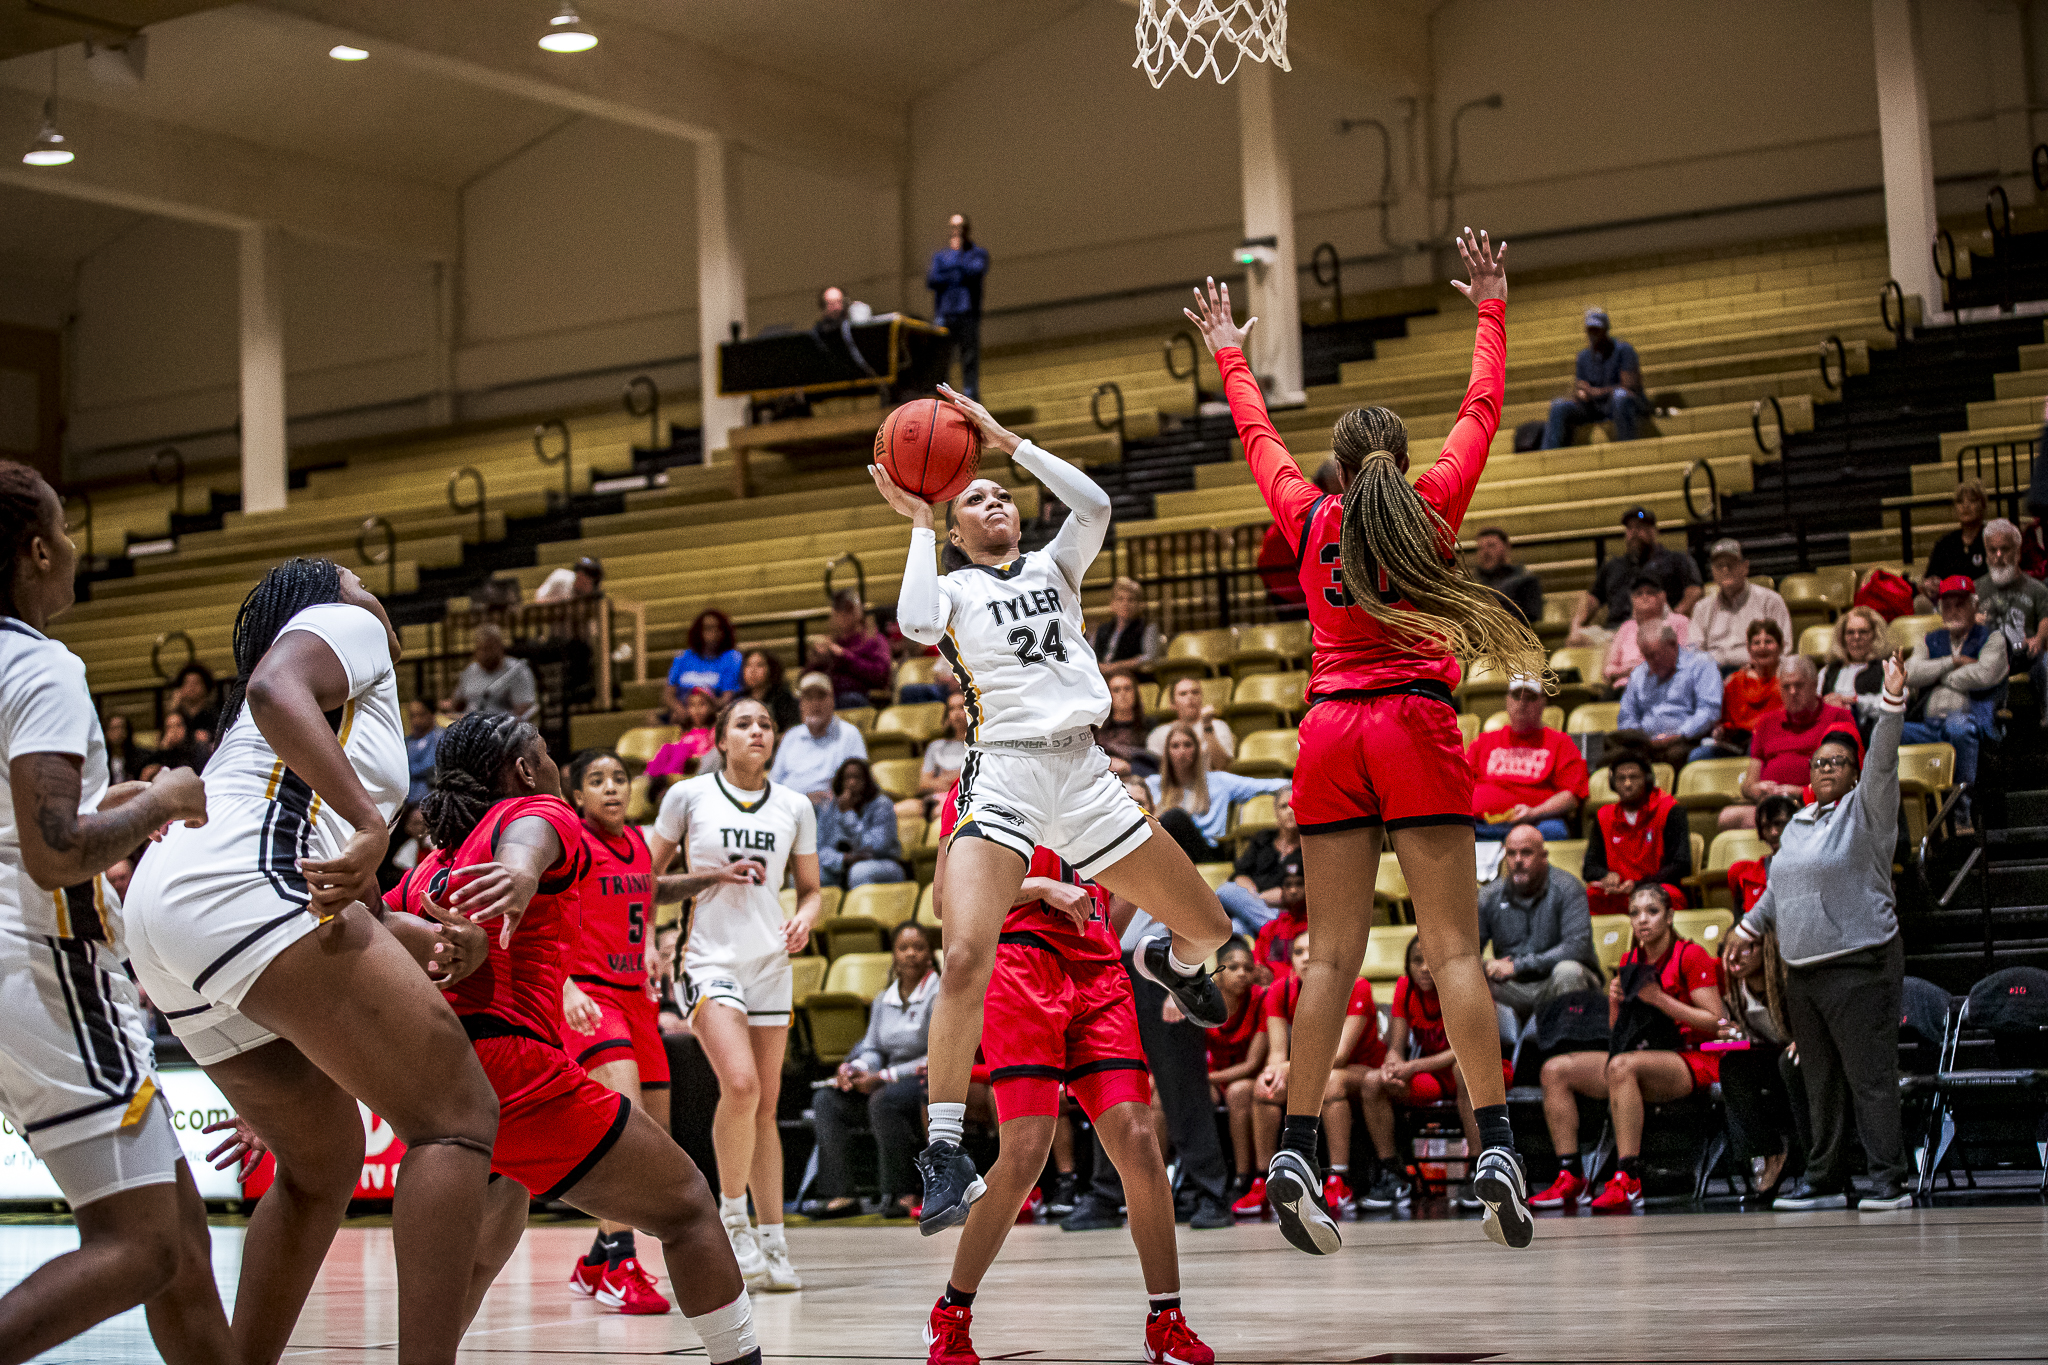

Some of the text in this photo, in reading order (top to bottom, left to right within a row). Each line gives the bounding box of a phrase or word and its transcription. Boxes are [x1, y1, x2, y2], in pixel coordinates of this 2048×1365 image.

[987, 586, 1063, 628] TYLER
[1007, 618, 1069, 668] 24
[720, 827, 776, 853] TYLER
[627, 900, 644, 944] 5
[607, 953, 645, 974] VALL
